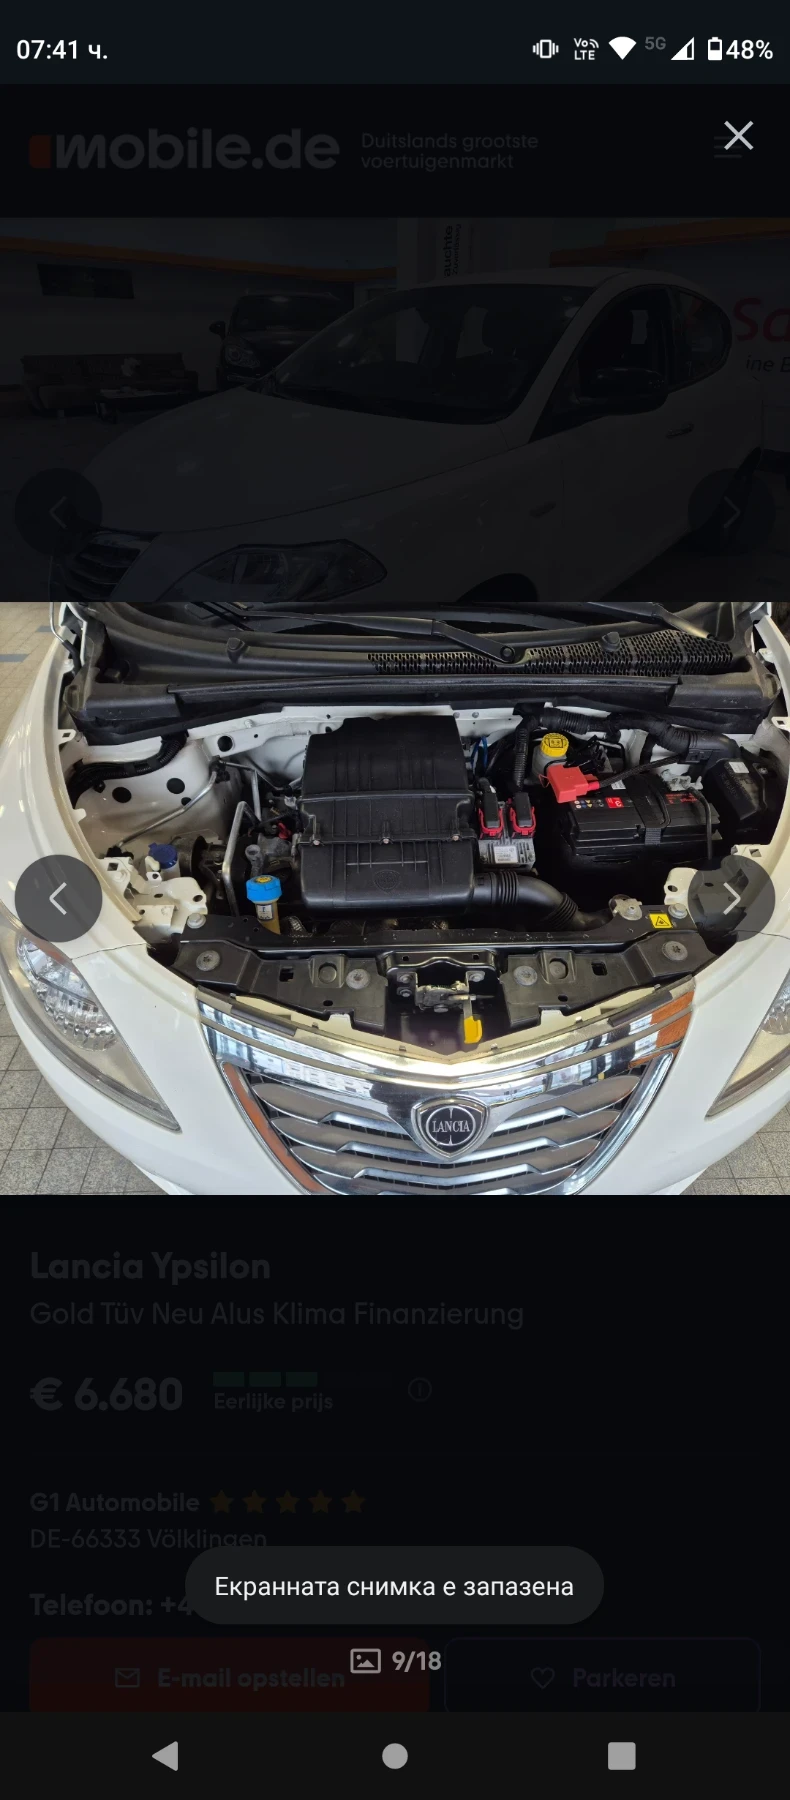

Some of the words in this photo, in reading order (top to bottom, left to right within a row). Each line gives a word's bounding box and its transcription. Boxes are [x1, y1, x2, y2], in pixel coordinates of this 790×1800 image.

[17, 40, 76, 59] 07:41
[89, 45, 107, 59] ч.
[645, 37, 666, 50] 5G
[726, 40, 774, 60] 48%
[574, 50, 596, 60] LTE
[56, 127, 340, 169] mobile.de
[362, 133, 457, 149] Duitslands
[463, 134, 538, 153] grootste
[361, 154, 514, 172] voertuigenmarkt
[432, 1120, 470, 1133] LANCIA
[31, 1251, 143, 1280] Lancia
[151, 1252, 271, 1286] Ypsilon
[31, 1302, 94, 1325] Gold
[101, 1302, 145, 1325] Tüv
[153, 1302, 203, 1325] Neu
[211, 1302, 265, 1325] Alus
[274, 1302, 345, 1325] Klima
[355, 1302, 524, 1331] Finanzierung
[30, 1377, 63, 1412] €
[75, 1377, 183, 1412] 6.680
[214, 1392, 286, 1412] Eerlijke
[292, 1393, 333, 1412] prijs
[30, 1493, 58, 1512] G1
[66, 1492, 200, 1512] Automobile
[31, 1529, 141, 1548] DE-66333
[147, 1529, 267, 1548] Völklingen
[215, 1577, 340, 1601] Екранната
[347, 1581, 436, 1597] снимка
[443, 1581, 456, 1597] е
[463, 1581, 574, 1597] запазена
[29, 1593, 153, 1616] Telefoon:
[392, 1651, 442, 1673] 9/18
[158, 1668, 230, 1688] E-mail
[238, 1668, 345, 1692] opstellen
[574, 1668, 676, 1688] Parkeren
